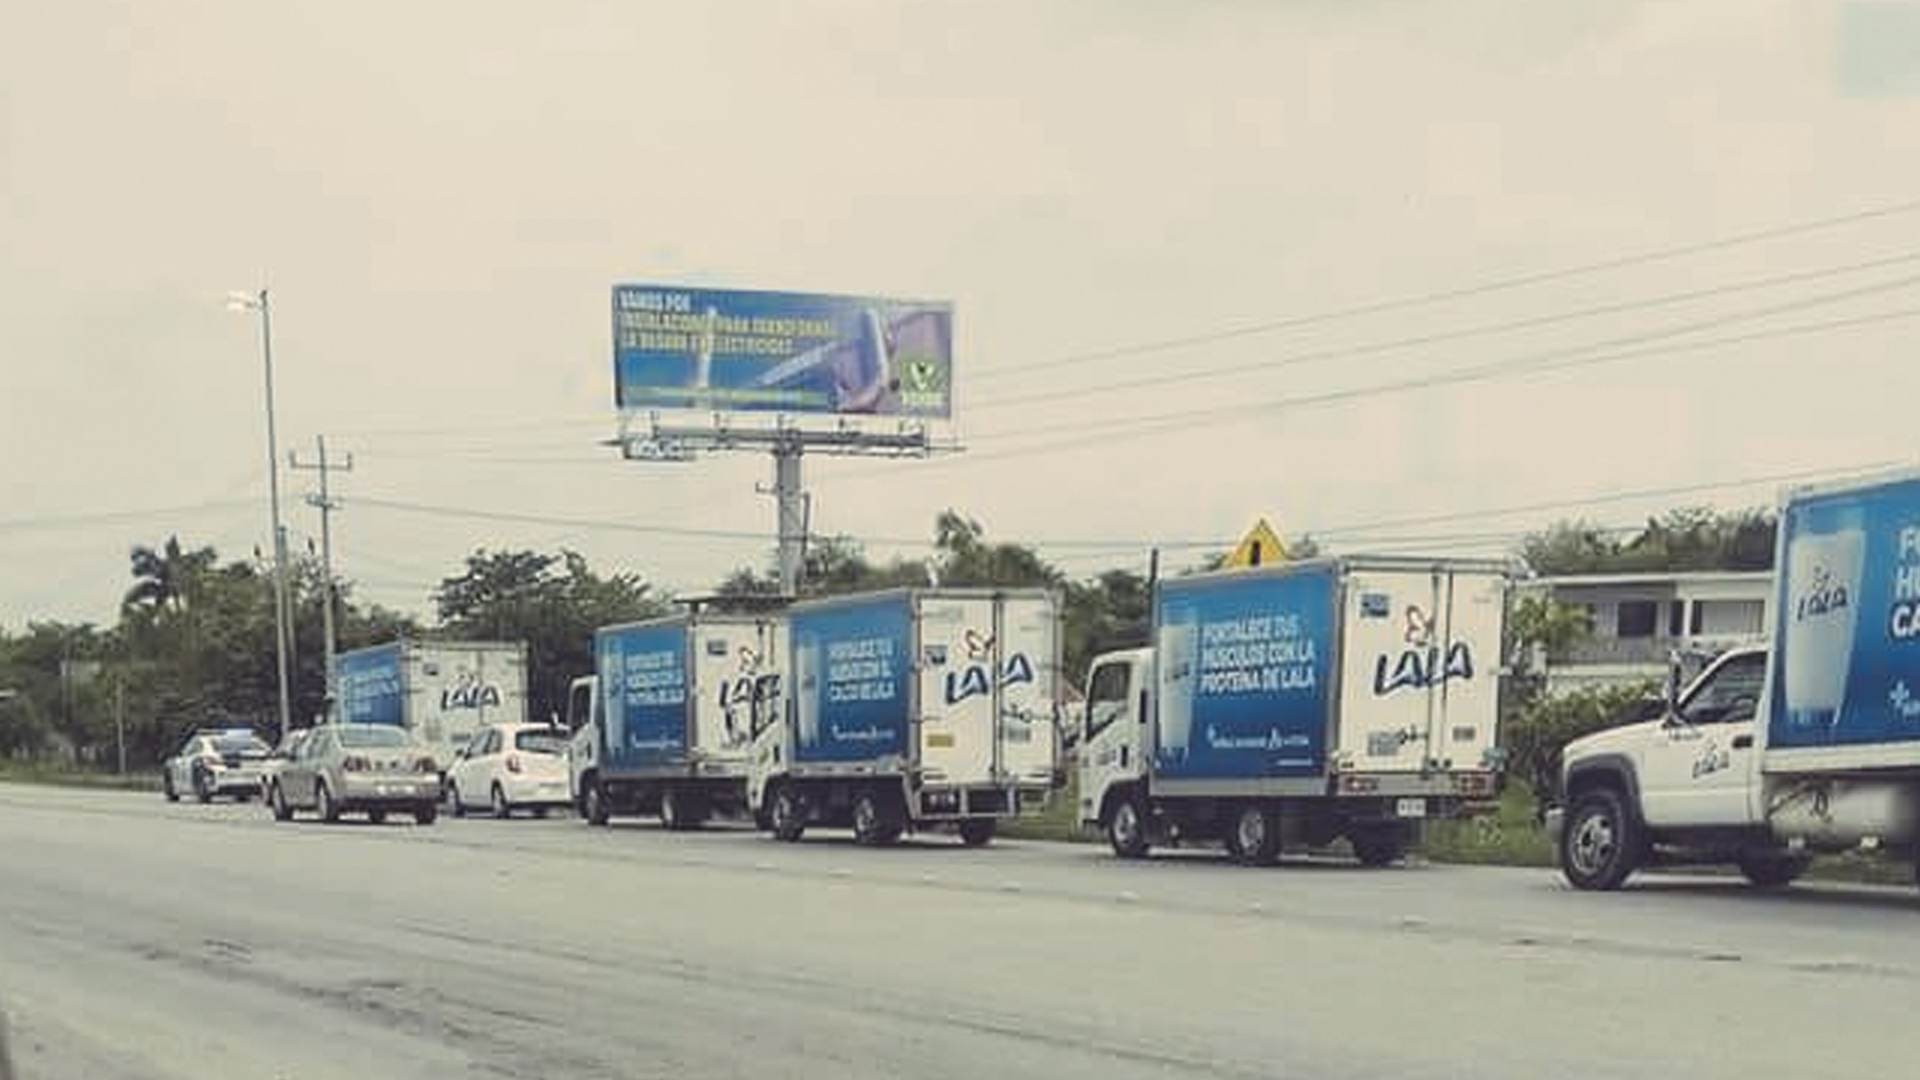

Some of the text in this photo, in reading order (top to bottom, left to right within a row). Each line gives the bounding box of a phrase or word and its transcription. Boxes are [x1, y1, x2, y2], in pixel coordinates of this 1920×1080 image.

[1798, 586, 1848, 622] LALA
[1298, 638, 1315, 662] LA
[1282, 664, 1316, 690] LALA
[1374, 641, 1473, 695] LALA
[441, 685, 500, 711] LALA
